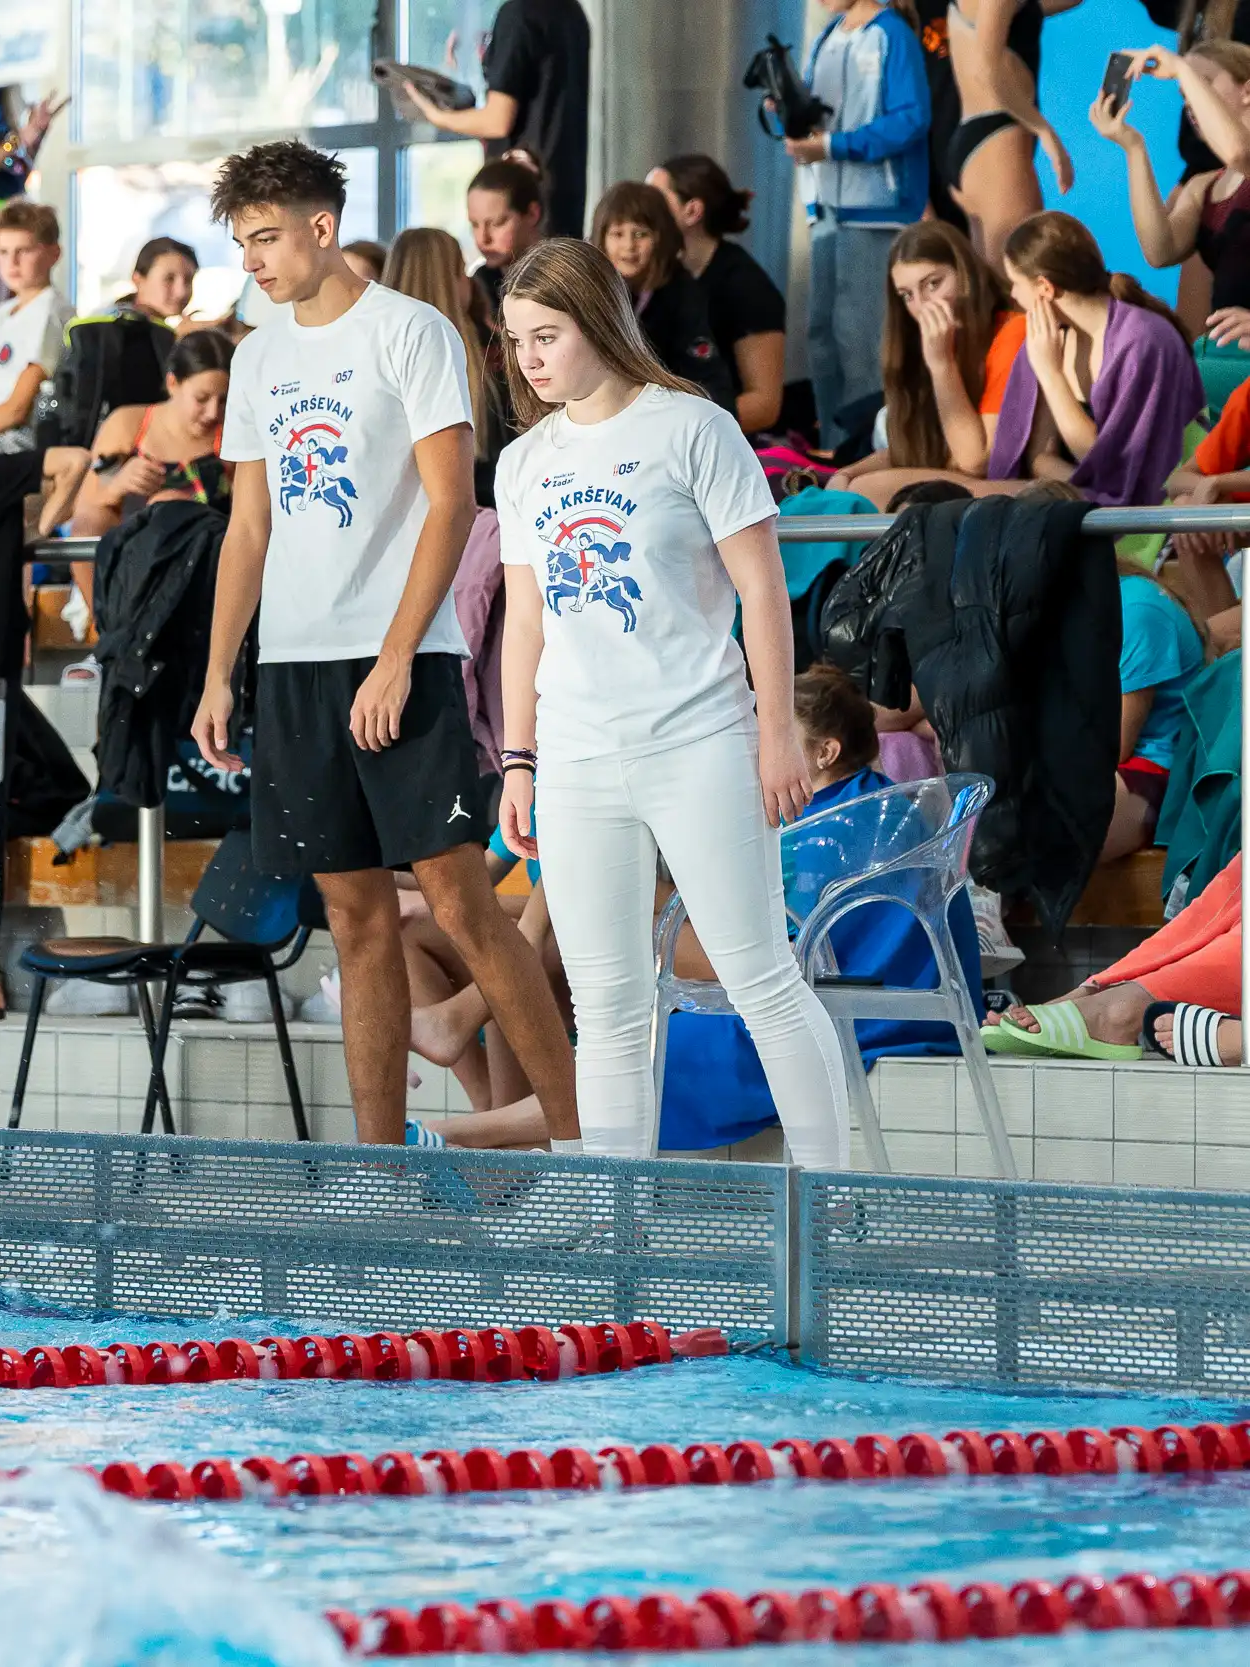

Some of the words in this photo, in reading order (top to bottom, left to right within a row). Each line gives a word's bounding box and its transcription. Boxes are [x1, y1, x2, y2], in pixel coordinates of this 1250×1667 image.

[335, 370, 353, 384] 057
[281, 386, 300, 395] Zadar
[269, 413, 289, 436] SV.
[290, 394, 353, 422] KRŠEVAN
[618, 461, 640, 475] 057
[552, 478, 574, 488] Zadar
[535, 505, 558, 531] SV.
[560, 485, 637, 516] KRŠEVAN
